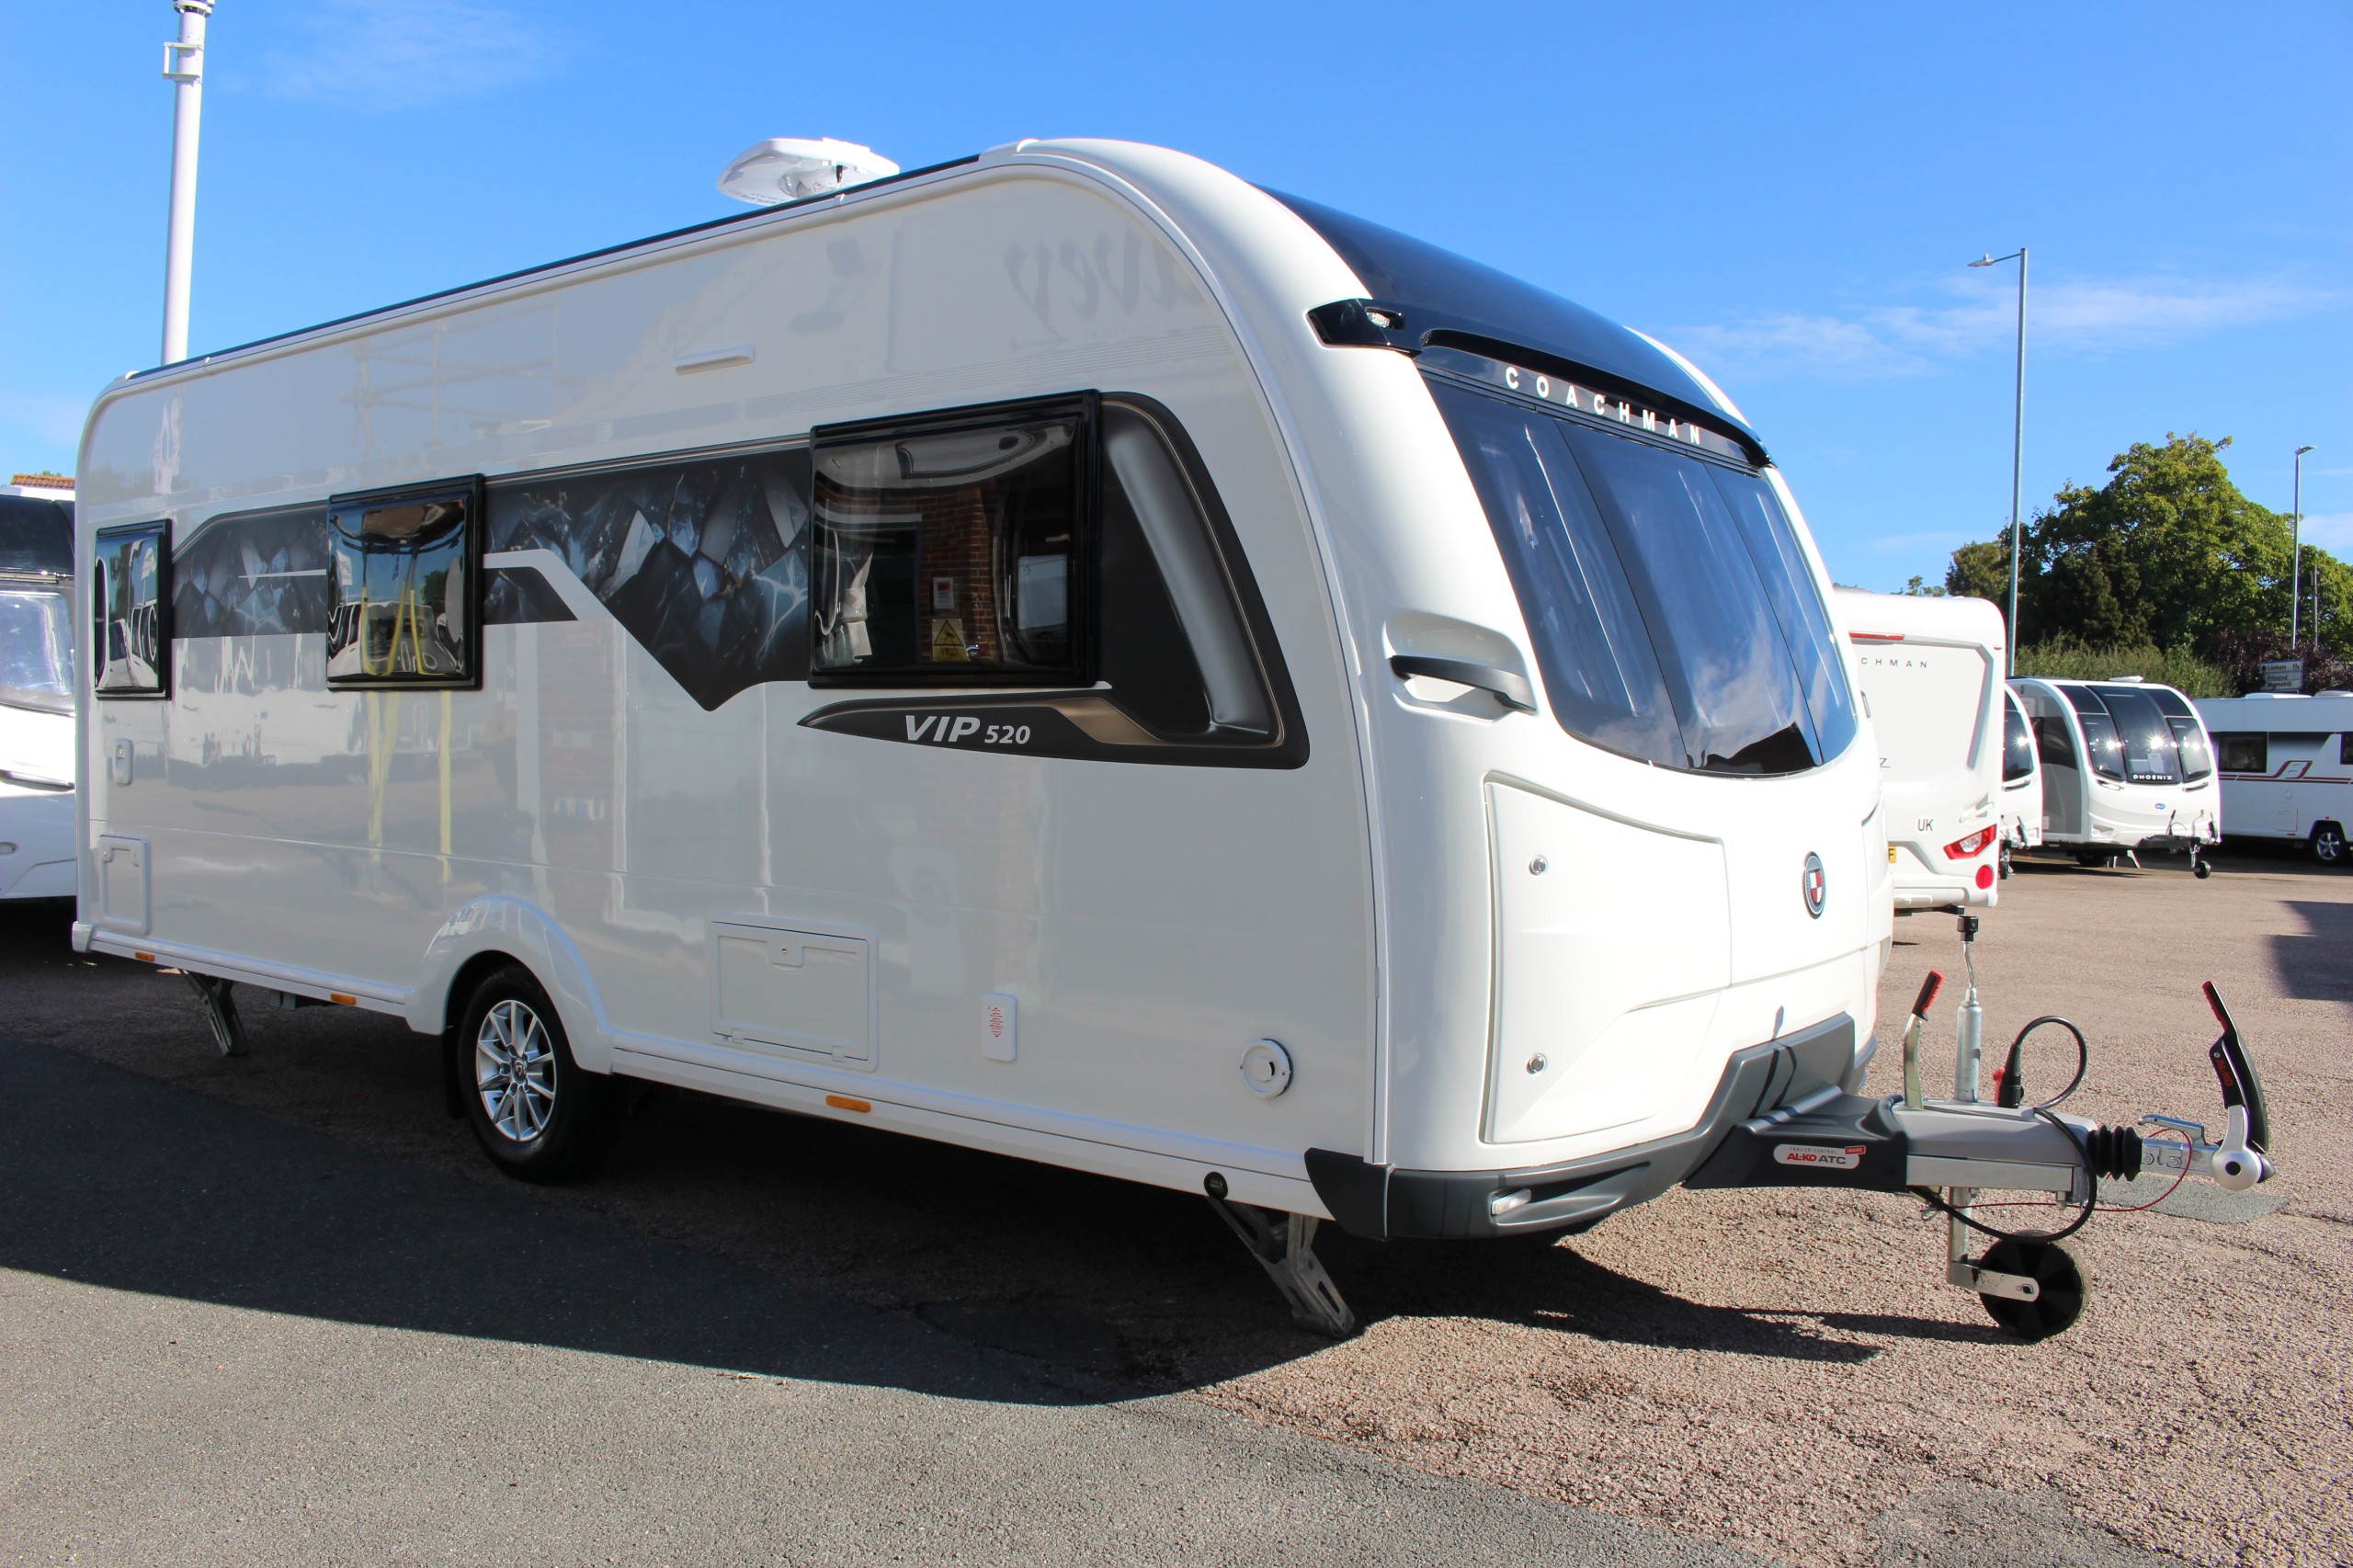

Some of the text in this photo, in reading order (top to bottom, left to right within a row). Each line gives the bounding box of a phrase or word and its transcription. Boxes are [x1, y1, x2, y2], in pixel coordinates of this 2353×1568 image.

[1506, 367, 1700, 445] COACHMAN
[1860, 657, 1927, 668] CHMAN
[905, 714, 1030, 744] VIP 520
[1917, 819, 1934, 832] UK
[1818, 1155, 1847, 1165] ATC
